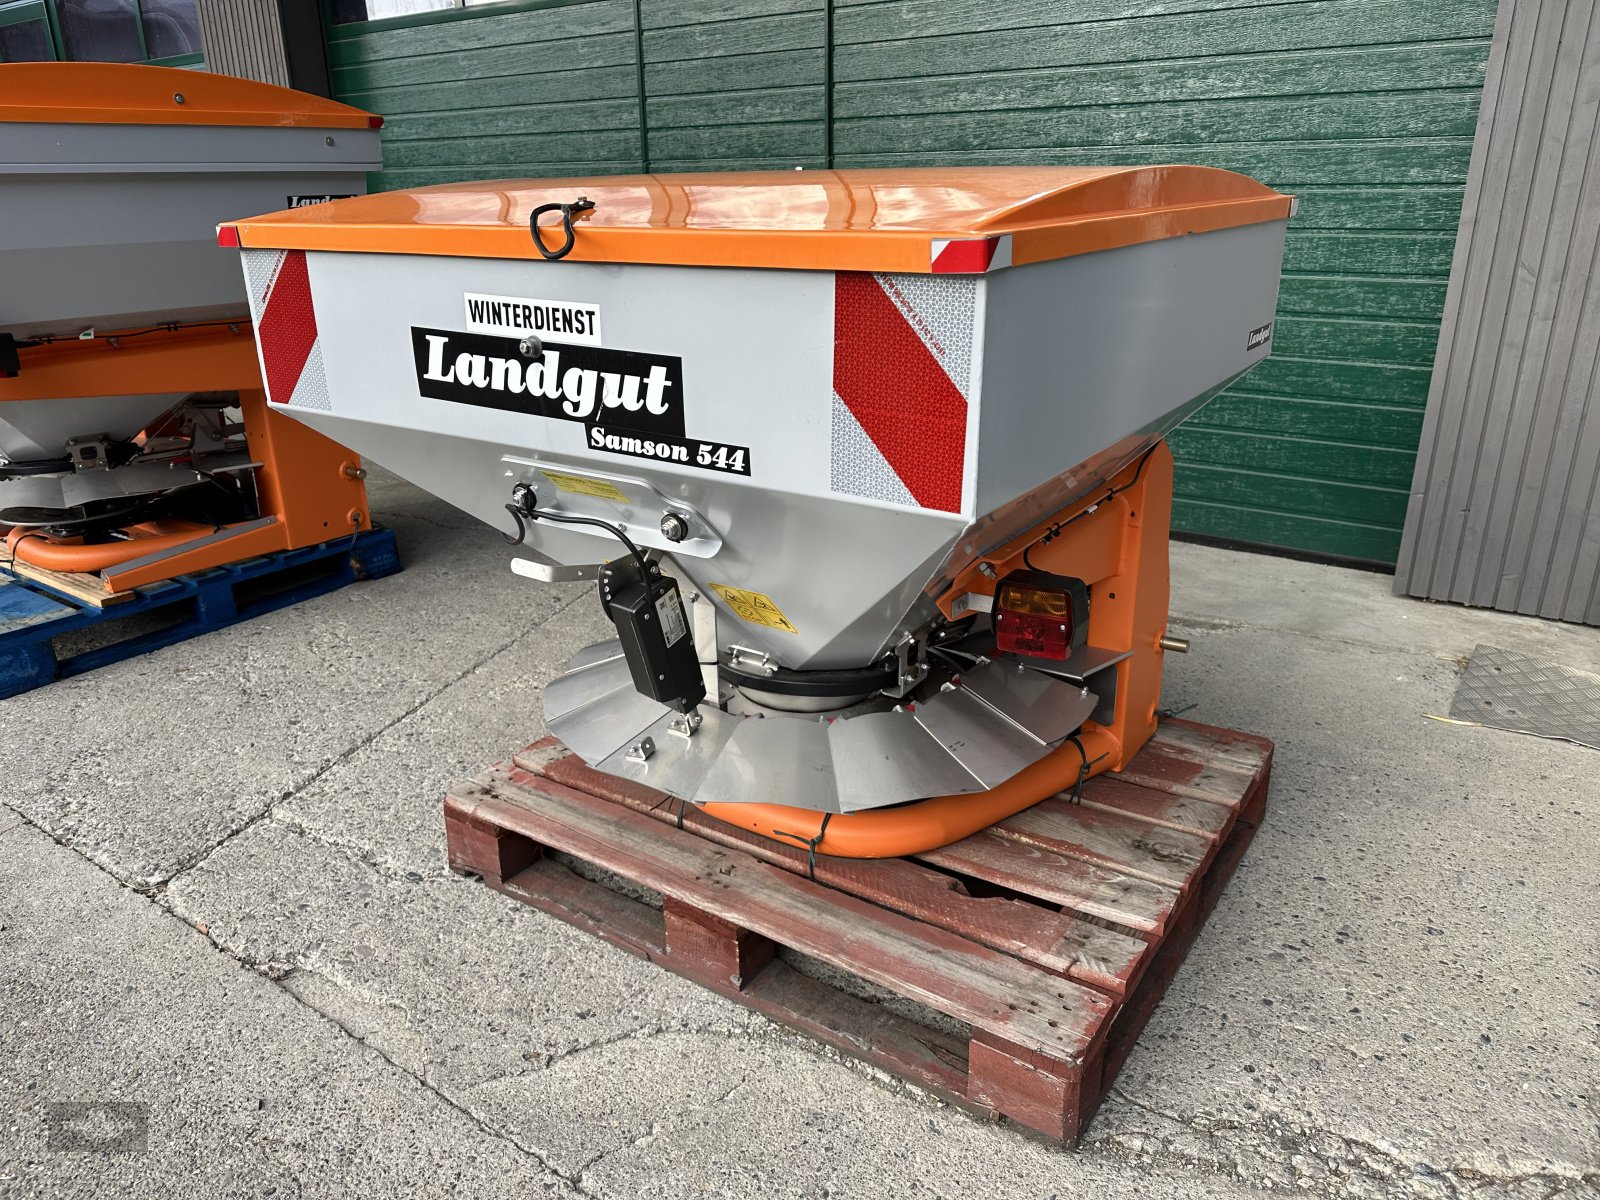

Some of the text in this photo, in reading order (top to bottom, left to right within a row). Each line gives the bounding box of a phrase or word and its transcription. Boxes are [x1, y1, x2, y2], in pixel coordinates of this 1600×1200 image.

[290, 195, 355, 208] Land
[468, 299, 596, 336] WINTERDIENST
[422, 334, 672, 418] Landgut
[590, 426, 746, 472] Samson 544
